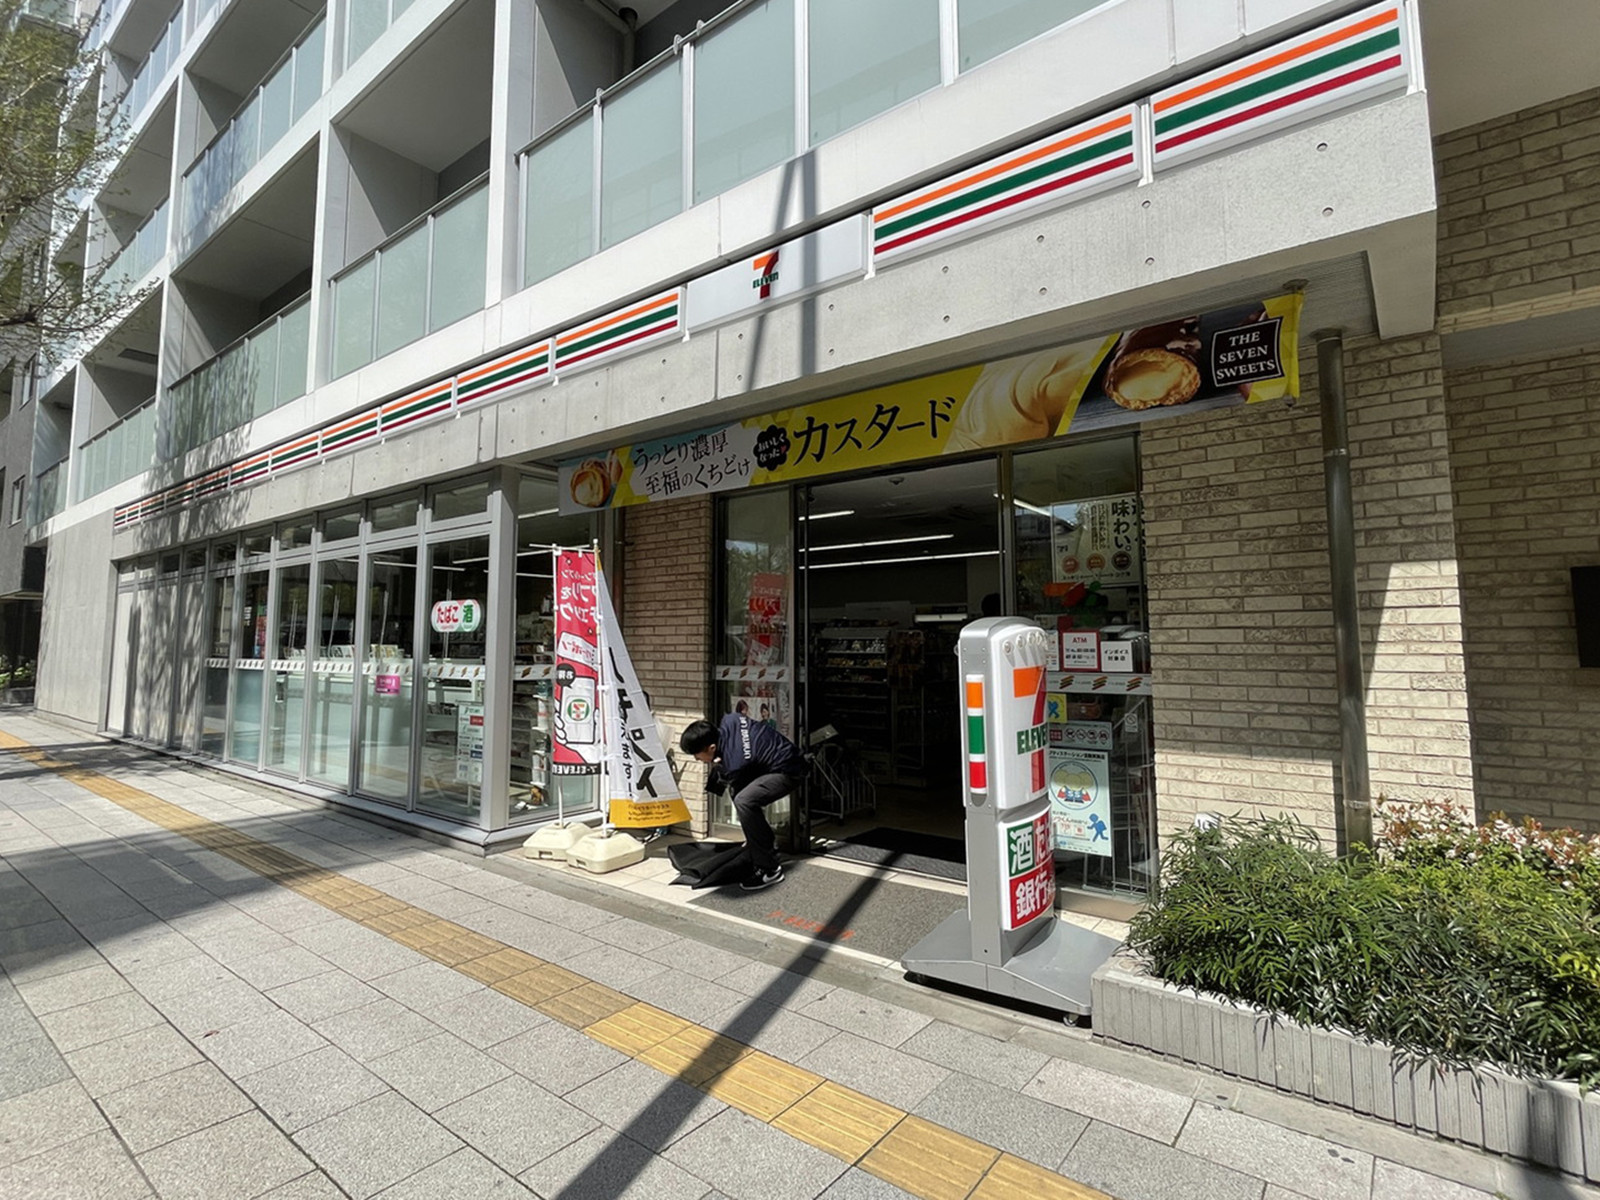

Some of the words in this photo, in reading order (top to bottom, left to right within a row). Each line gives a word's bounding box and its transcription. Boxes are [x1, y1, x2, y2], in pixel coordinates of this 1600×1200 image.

[1229, 331, 1260, 347] THE
[1219, 345, 1268, 364] SEVEN
[1216, 359, 1275, 380] SWEETS
[793, 396, 956, 466] カスタード
[633, 429, 729, 476] うっとり濃厚
[758, 433, 785, 452] おいしく
[760, 448, 780, 462] なった
[645, 454, 750, 496] 至福のくちどけ
[437, 605, 459, 624] たばこ
[463, 604, 473, 623] 酒
[1072, 636, 1088, 644] ATM
[1016, 721, 1048, 755] ELEVE
[1010, 825, 1033, 874] 酒
[1016, 871, 1056, 919] 銀行
